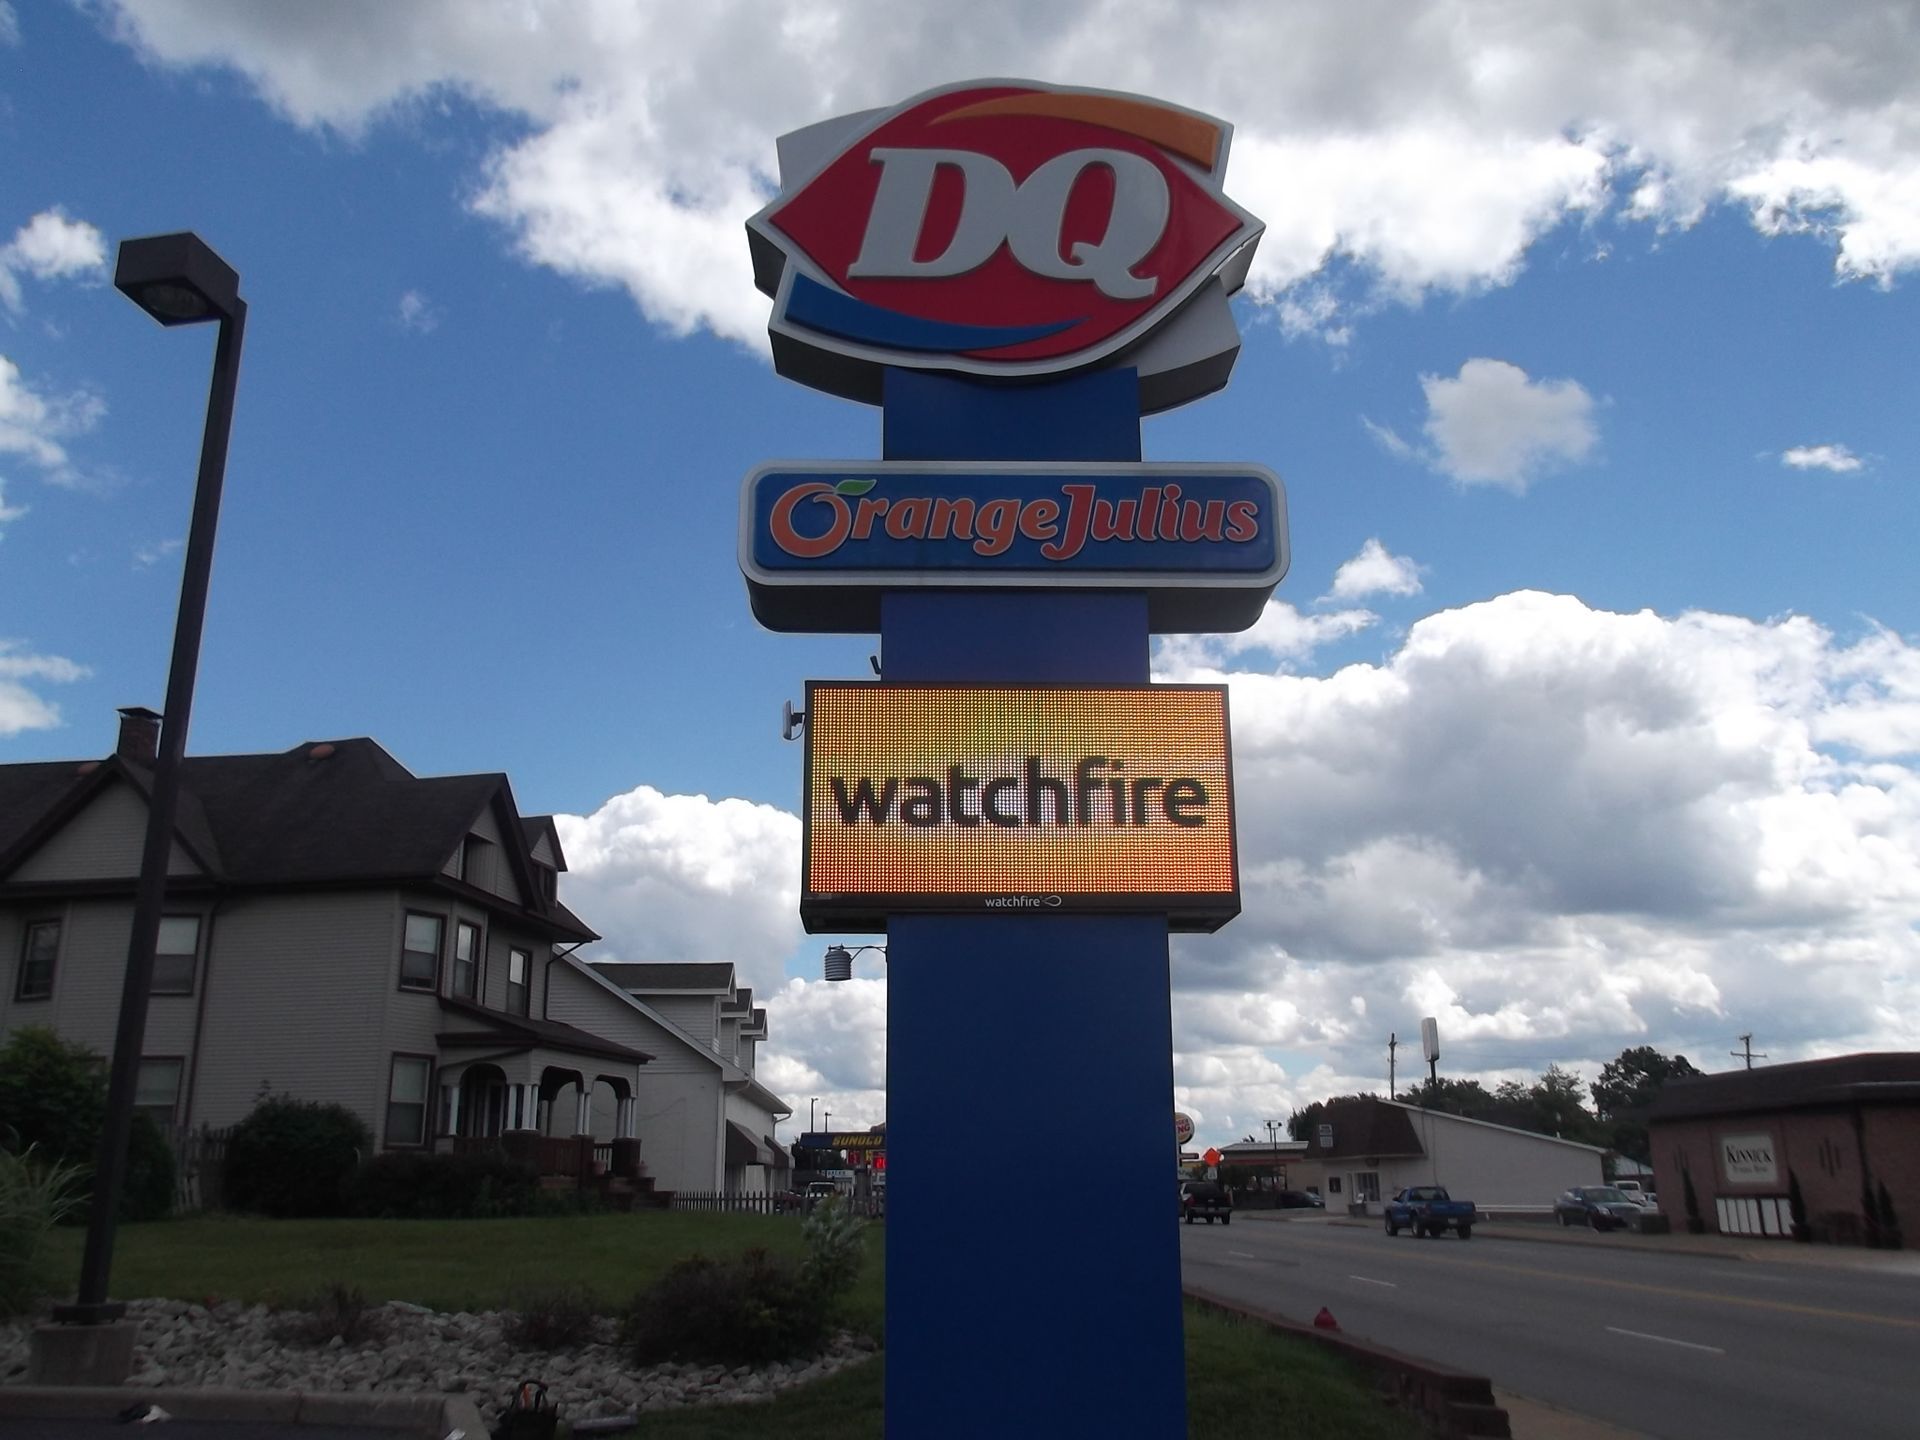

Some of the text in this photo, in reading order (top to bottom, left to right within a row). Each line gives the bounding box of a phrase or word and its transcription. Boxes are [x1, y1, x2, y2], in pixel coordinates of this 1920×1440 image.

[847, 148, 1172, 300] DQ
[830, 755, 1208, 828] watchfire
[985, 895, 1041, 907] watchfire
[831, 1136, 883, 1146] SUNOCO
